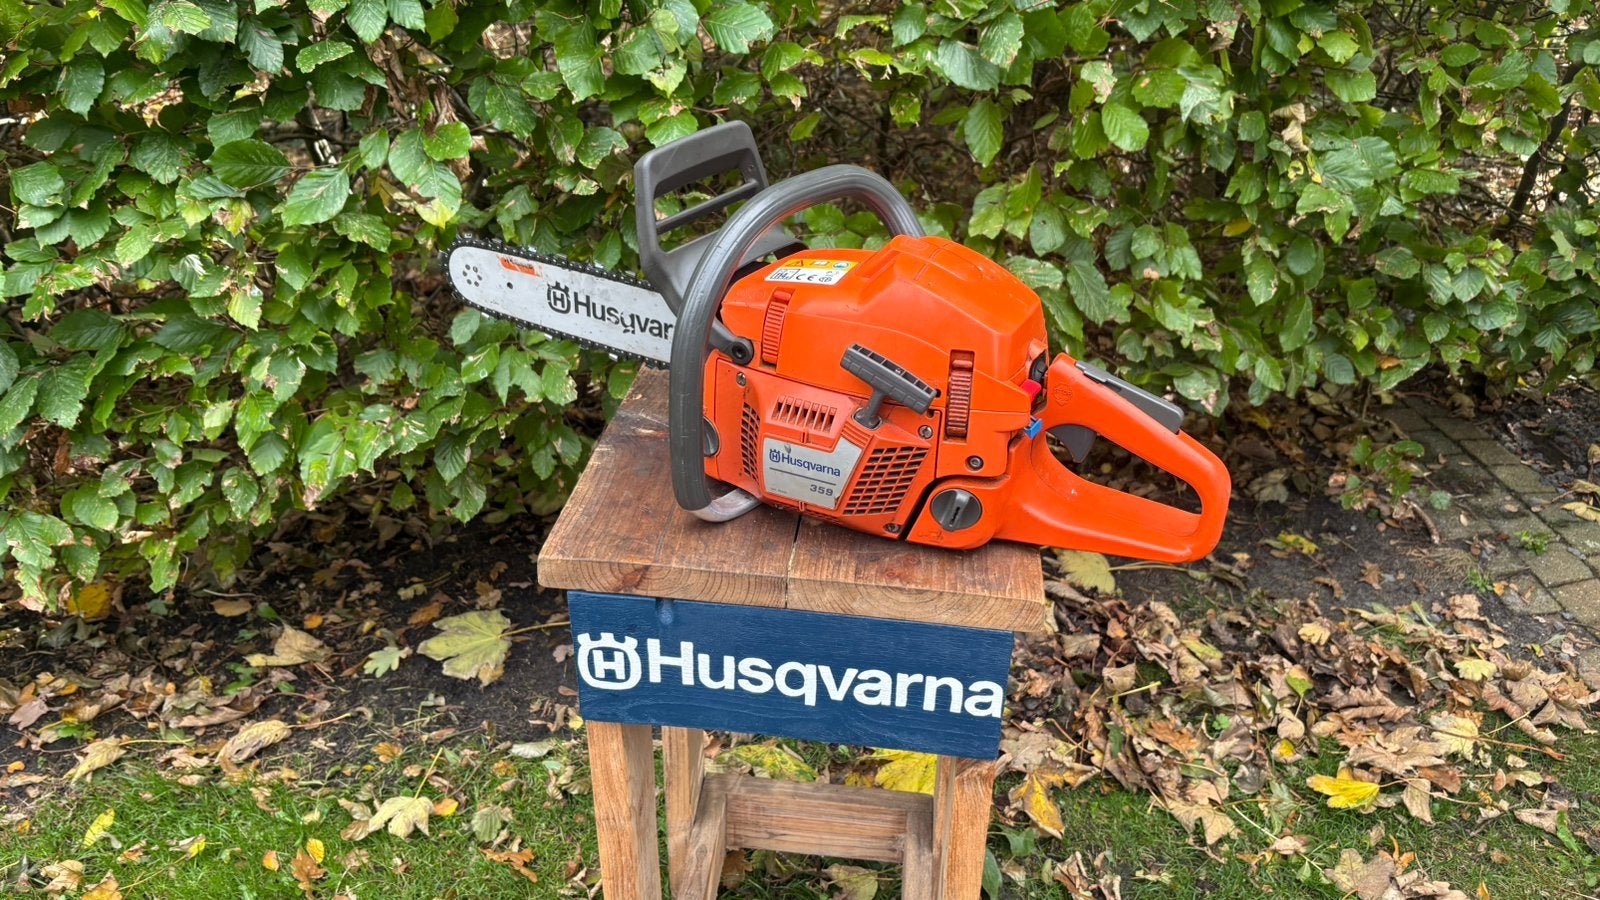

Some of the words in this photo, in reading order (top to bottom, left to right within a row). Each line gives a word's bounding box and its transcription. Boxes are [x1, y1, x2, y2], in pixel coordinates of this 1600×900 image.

[782, 453, 840, 477] Husqvarna
[810, 484, 833, 496] 359
[647, 638, 1004, 718] Husqvarna
